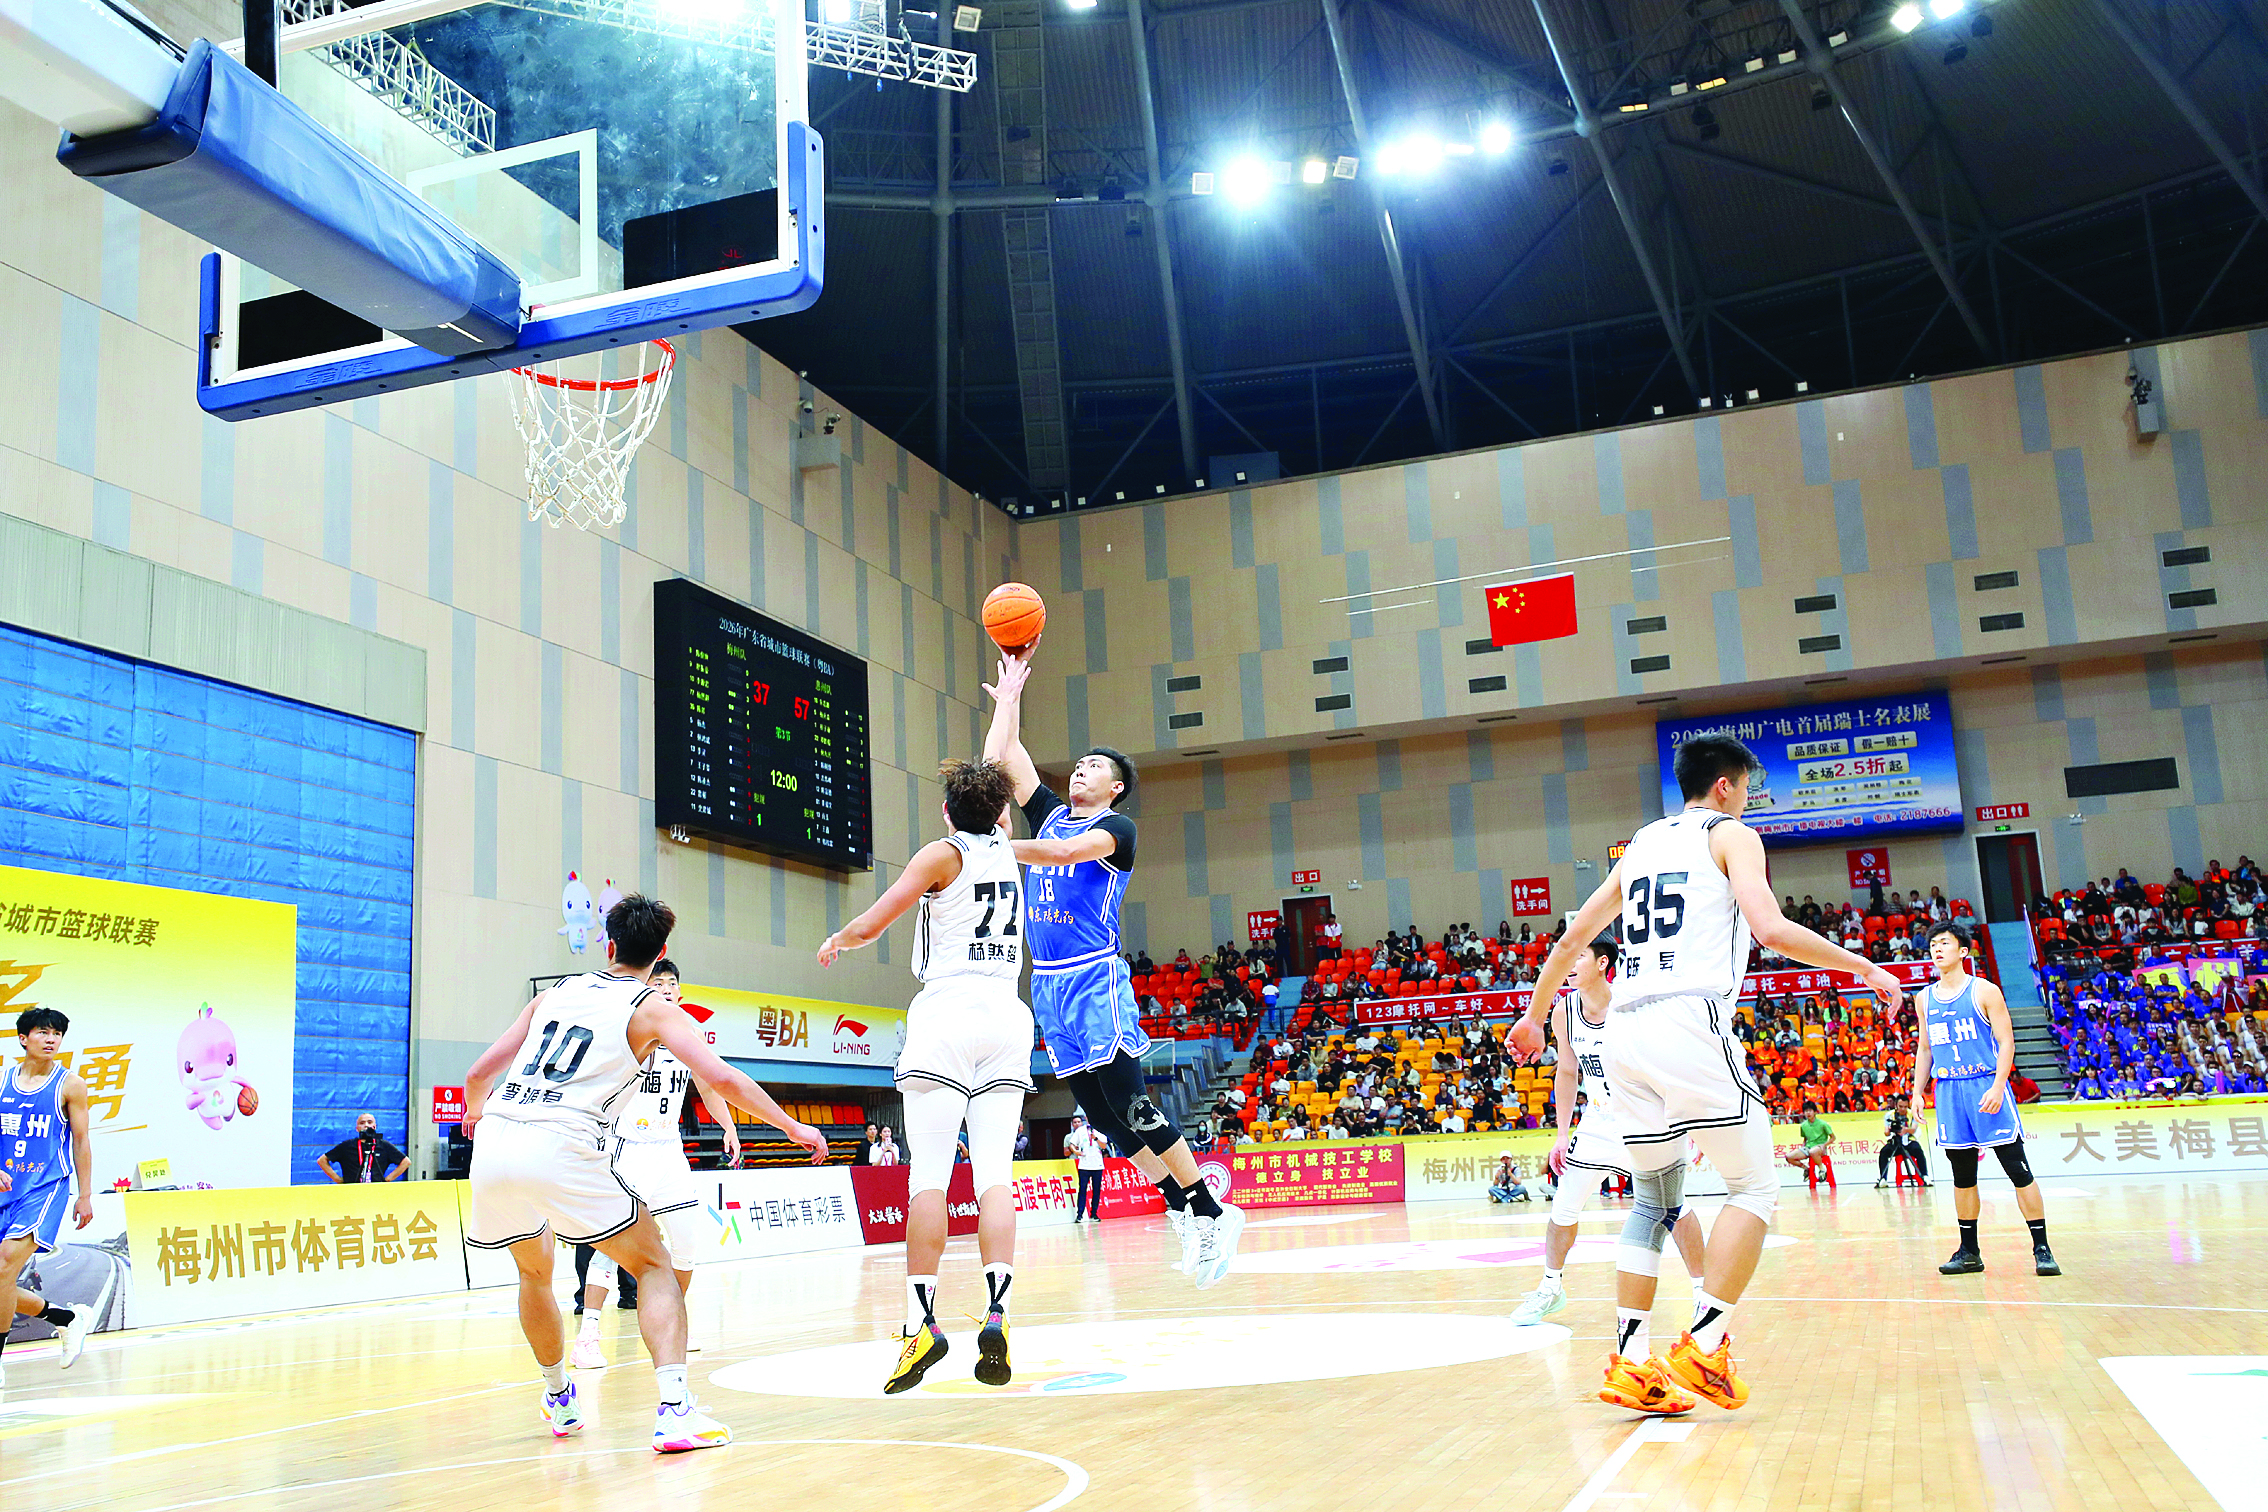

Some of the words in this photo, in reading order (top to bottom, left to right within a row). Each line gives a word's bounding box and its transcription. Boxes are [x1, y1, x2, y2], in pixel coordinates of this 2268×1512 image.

[753, 680, 770, 705] 37
[794, 697, 810, 720] 57
[776, 726, 791, 741] 第3节
[1794, 741, 1841, 757] 品质保证
[1861, 734, 1910, 751] 假一赔十
[770, 769, 797, 792] 12:00
[1805, 757, 1904, 781] 全场2.5折起
[757, 814, 762, 826] 1
[1901, 806, 1951, 821] 2187666
[1982, 807, 2008, 820] 出口
[806, 828, 811, 839] 1
[1295, 872, 1318, 883] 出口
[1038, 878, 1055, 902] 18
[974, 881, 1019, 938] 77
[1516, 899, 1548, 911] 洗手间
[1627, 871, 1689, 944] 35
[0, 902, 160, 947] 城市篮球联赛
[756, 1005, 808, 1048] 粤BA
[1929, 1017, 1978, 1047] 惠州
[521, 1020, 594, 1083] 10
[833, 1041, 871, 1056] LI-NING
[1952, 1045, 1961, 1062] 1
[640, 1069, 688, 1093] 梅州
[660, 1098, 668, 1114] 8
[0, 1113, 51, 1138] 惠州
[1940, 1124, 1947, 1141] 1
[14, 1140, 27, 1158] 9
[2060, 1117, 2268, 1164] 大美梅县
[1233, 1148, 1393, 1171] 梅州市机械技工学校
[1256, 1172, 1302, 1184] 德立身
[1322, 1166, 1369, 1181] 技立业
[749, 1196, 846, 1231] 中国体育彩票
[157, 1210, 438, 1287] 梅州市体育总会
